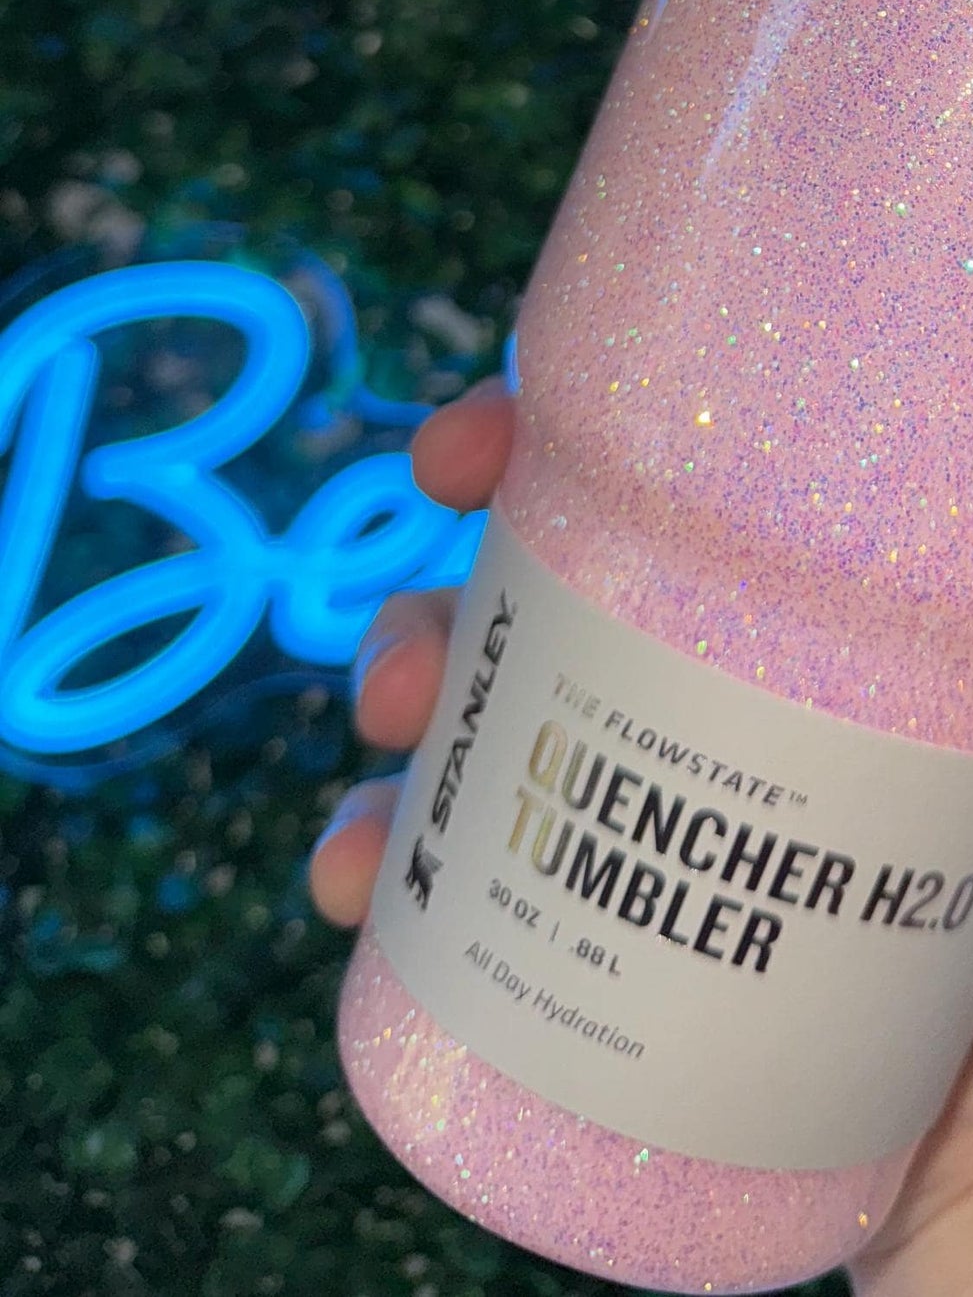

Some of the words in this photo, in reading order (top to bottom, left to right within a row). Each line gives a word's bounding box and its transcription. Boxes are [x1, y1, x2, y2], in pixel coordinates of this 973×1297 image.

[431, 588, 517, 834] STANLEY
[553, 672, 602, 720] THE
[507, 785, 783, 973] TUMBLER
[528, 719, 857, 916] QUENCHER
[464, 939, 495, 971] All
[491, 959, 532, 1000] Day
[532, 987, 646, 1060] Hydration
[488, 877, 513, 907] 30
[513, 897, 542, 928] OZ
[608, 953, 622, 978] L
